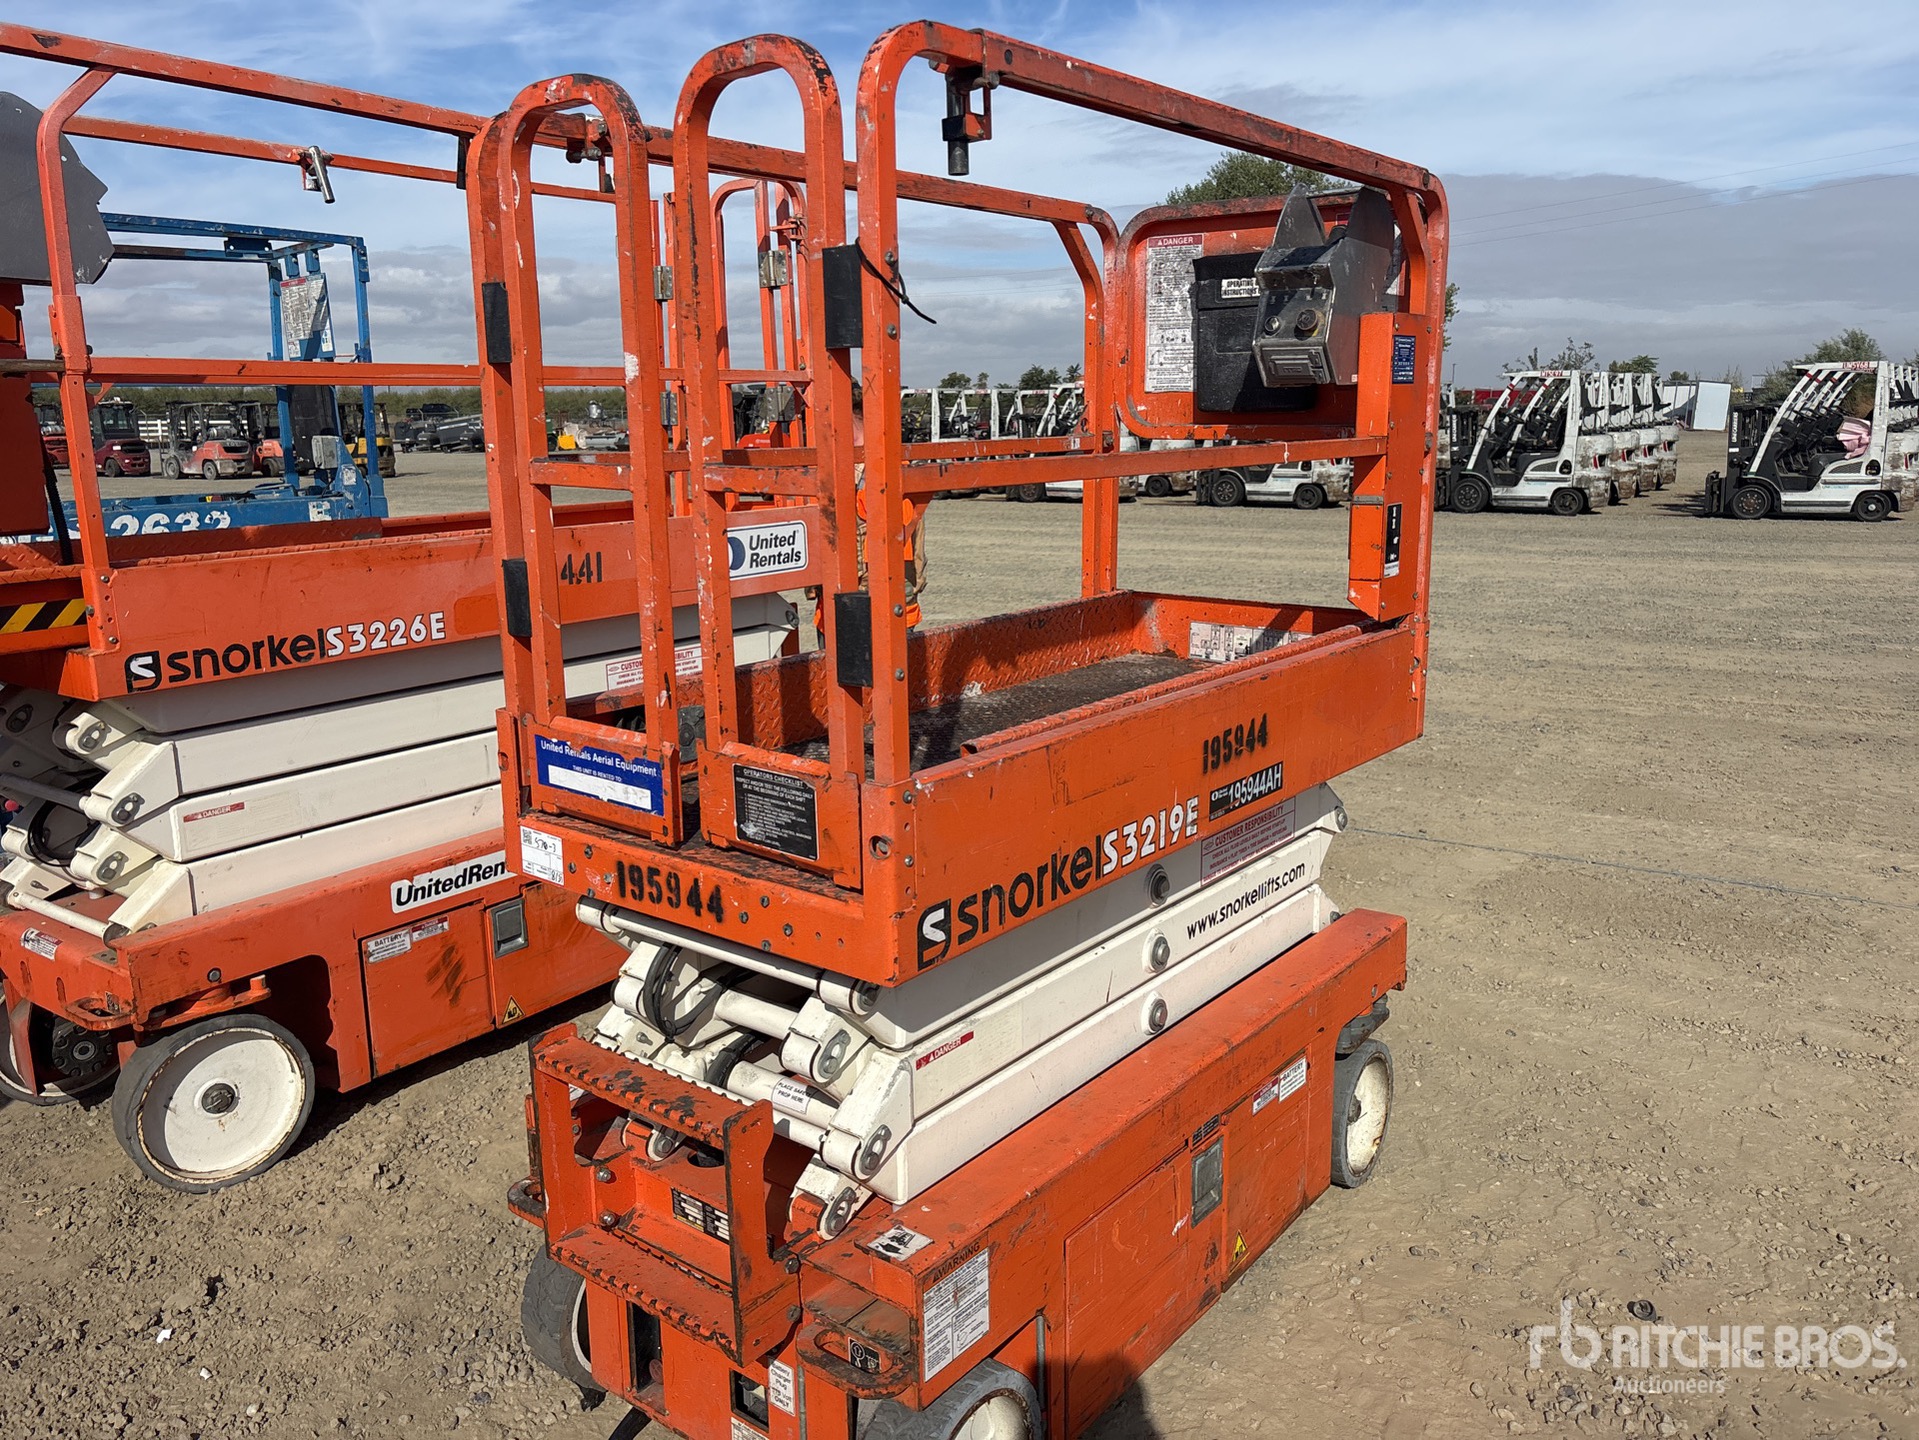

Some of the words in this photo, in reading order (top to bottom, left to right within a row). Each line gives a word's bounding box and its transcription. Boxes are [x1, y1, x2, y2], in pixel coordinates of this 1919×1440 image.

[1164, 237, 1194, 246] DANGER
[749, 530, 796, 551] United
[749, 548, 802, 569] Rentals
[168, 627, 327, 684] snorkel
[325, 610, 447, 658] S3226E
[540, 740, 564, 755] United
[592, 752, 614, 767] Aerial
[615, 757, 657, 777] Equipment
[1202, 712, 1268, 774] 195944
[1214, 827, 1244, 847] CUSTOMER
[1244, 805, 1284, 831] RESPONSIBILITY
[957, 834, 1102, 946] snorkel
[1102, 795, 1200, 877] S3219E
[616, 860, 725, 924] 195944
[1187, 863, 1305, 940] www.snorkellifts.com
[374, 932, 403, 948] BATTERY
[934, 1038, 961, 1059] DANGER
[778, 1082, 794, 1092] PLACE
[1283, 1062, 1303, 1082] BATTERY
[938, 1241, 981, 1279] WARNING
